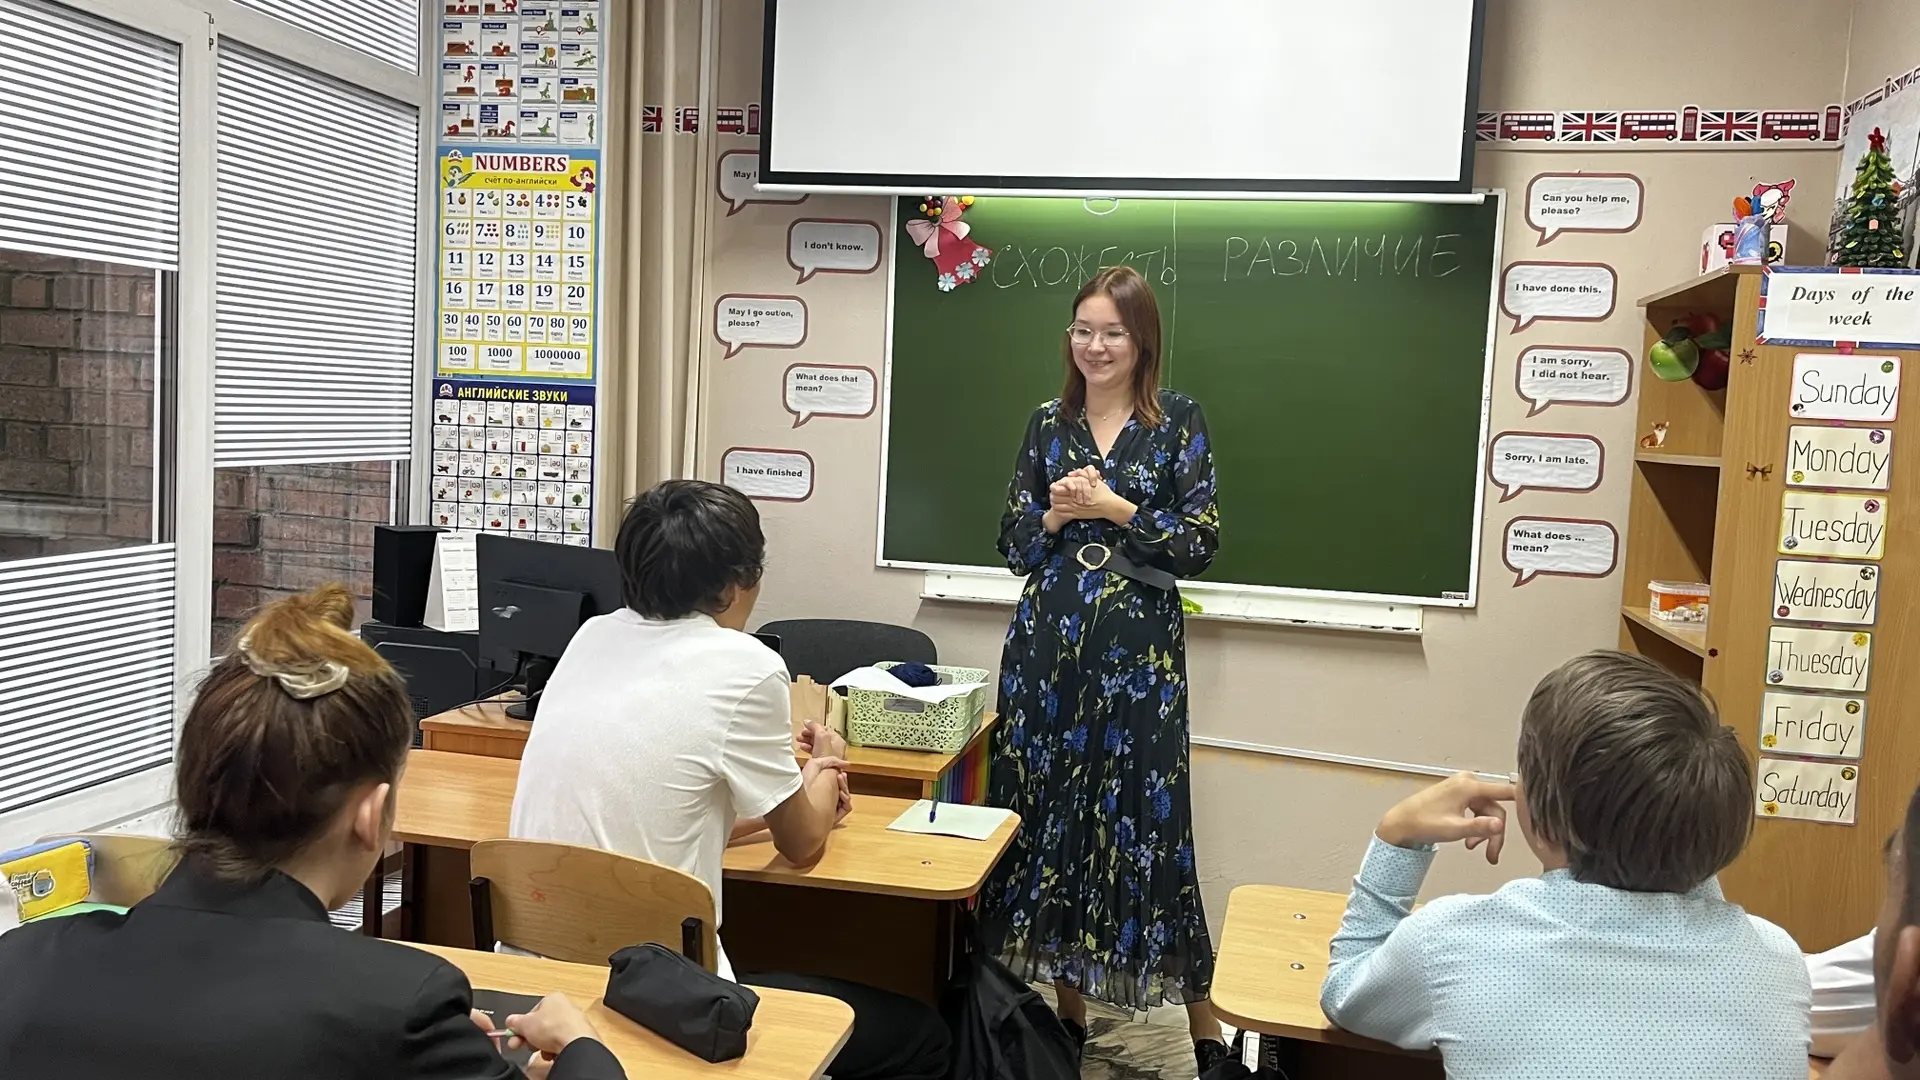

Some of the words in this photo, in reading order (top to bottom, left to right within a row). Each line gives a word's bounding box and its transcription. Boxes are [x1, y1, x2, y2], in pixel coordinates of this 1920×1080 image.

[475, 155, 567, 172] NUMBERS
[734, 171, 751, 179] May
[503, 177, 558, 186] по-английски
[446, 192, 454, 204] 1
[476, 192, 484, 205] 2
[506, 194, 515, 206] 3
[535, 194, 545, 207] 4
[566, 196, 574, 208] 5
[1542, 194, 1562, 202] Can
[1565, 196, 1583, 204] you
[1586, 195, 1608, 204] help
[1611, 196, 1630, 204] me,
[446, 223, 454, 236] 6
[475, 224, 484, 236] 7
[506, 224, 515, 237] 8
[535, 225, 544, 238] 9
[568, 226, 585, 239] 10
[804, 241, 807, 249] I
[810, 242, 834, 250] don't
[836, 243, 864, 251] know.
[448, 252, 463, 264] 11
[478, 253, 494, 265] 12
[508, 254, 524, 266] 13
[536, 255, 553, 267] 14
[568, 256, 585, 268] 15
[1223, 234, 1461, 281] РАЗЛИЧИЕ
[446, 282, 462, 294] 16
[478, 283, 494, 294] 17
[508, 284, 524, 296] 18
[536, 285, 552, 296] 19
[568, 286, 585, 298] 20
[1522, 284, 1547, 292] have
[1550, 285, 1575, 293] done
[1579, 285, 1602, 293] this.
[1791, 286, 1836, 304] Days
[1851, 286, 1874, 304] of
[1886, 286, 1914, 301] the
[444, 314, 458, 324] 30
[728, 308, 745, 317] May
[753, 310, 763, 318] go
[765, 310, 794, 318] out/on,
[1829, 311, 1872, 326] week
[465, 314, 480, 325] 40
[486, 315, 501, 326] 50
[507, 316, 521, 327] 60
[530, 317, 544, 327] 70
[550, 318, 564, 328] 80
[572, 319, 586, 329] 90
[449, 346, 467, 355] 100
[488, 348, 512, 357] 1000
[534, 349, 580, 360] 1000000
[1561, 358, 1592, 367] sorry,
[795, 373, 817, 381] What
[819, 374, 839, 382] does
[841, 375, 858, 383] that
[1539, 370, 1556, 378] did
[1581, 372, 1610, 380] hear.
[458, 386, 529, 400] АНГЛИЙСКИЕ
[532, 390, 568, 402] ЗВУКИ
[1800, 370, 1898, 416] Sunday
[1505, 453, 1535, 463] Sorry,
[1565, 456, 1589, 464] late.
[1792, 440, 1889, 484] Monday
[742, 467, 764, 475] have
[766, 468, 803, 477] finished
[1513, 530, 1541, 539] What
[1545, 531, 1572, 541] does
[1784, 508, 1883, 555] Tuesday
[1512, 544, 1549, 553] mean?
[1776, 574, 1876, 620] Wednesday
[1771, 640, 1867, 688] Thuesday
[1774, 706, 1854, 755] Friday
[1760, 772, 1851, 818] Saturday
